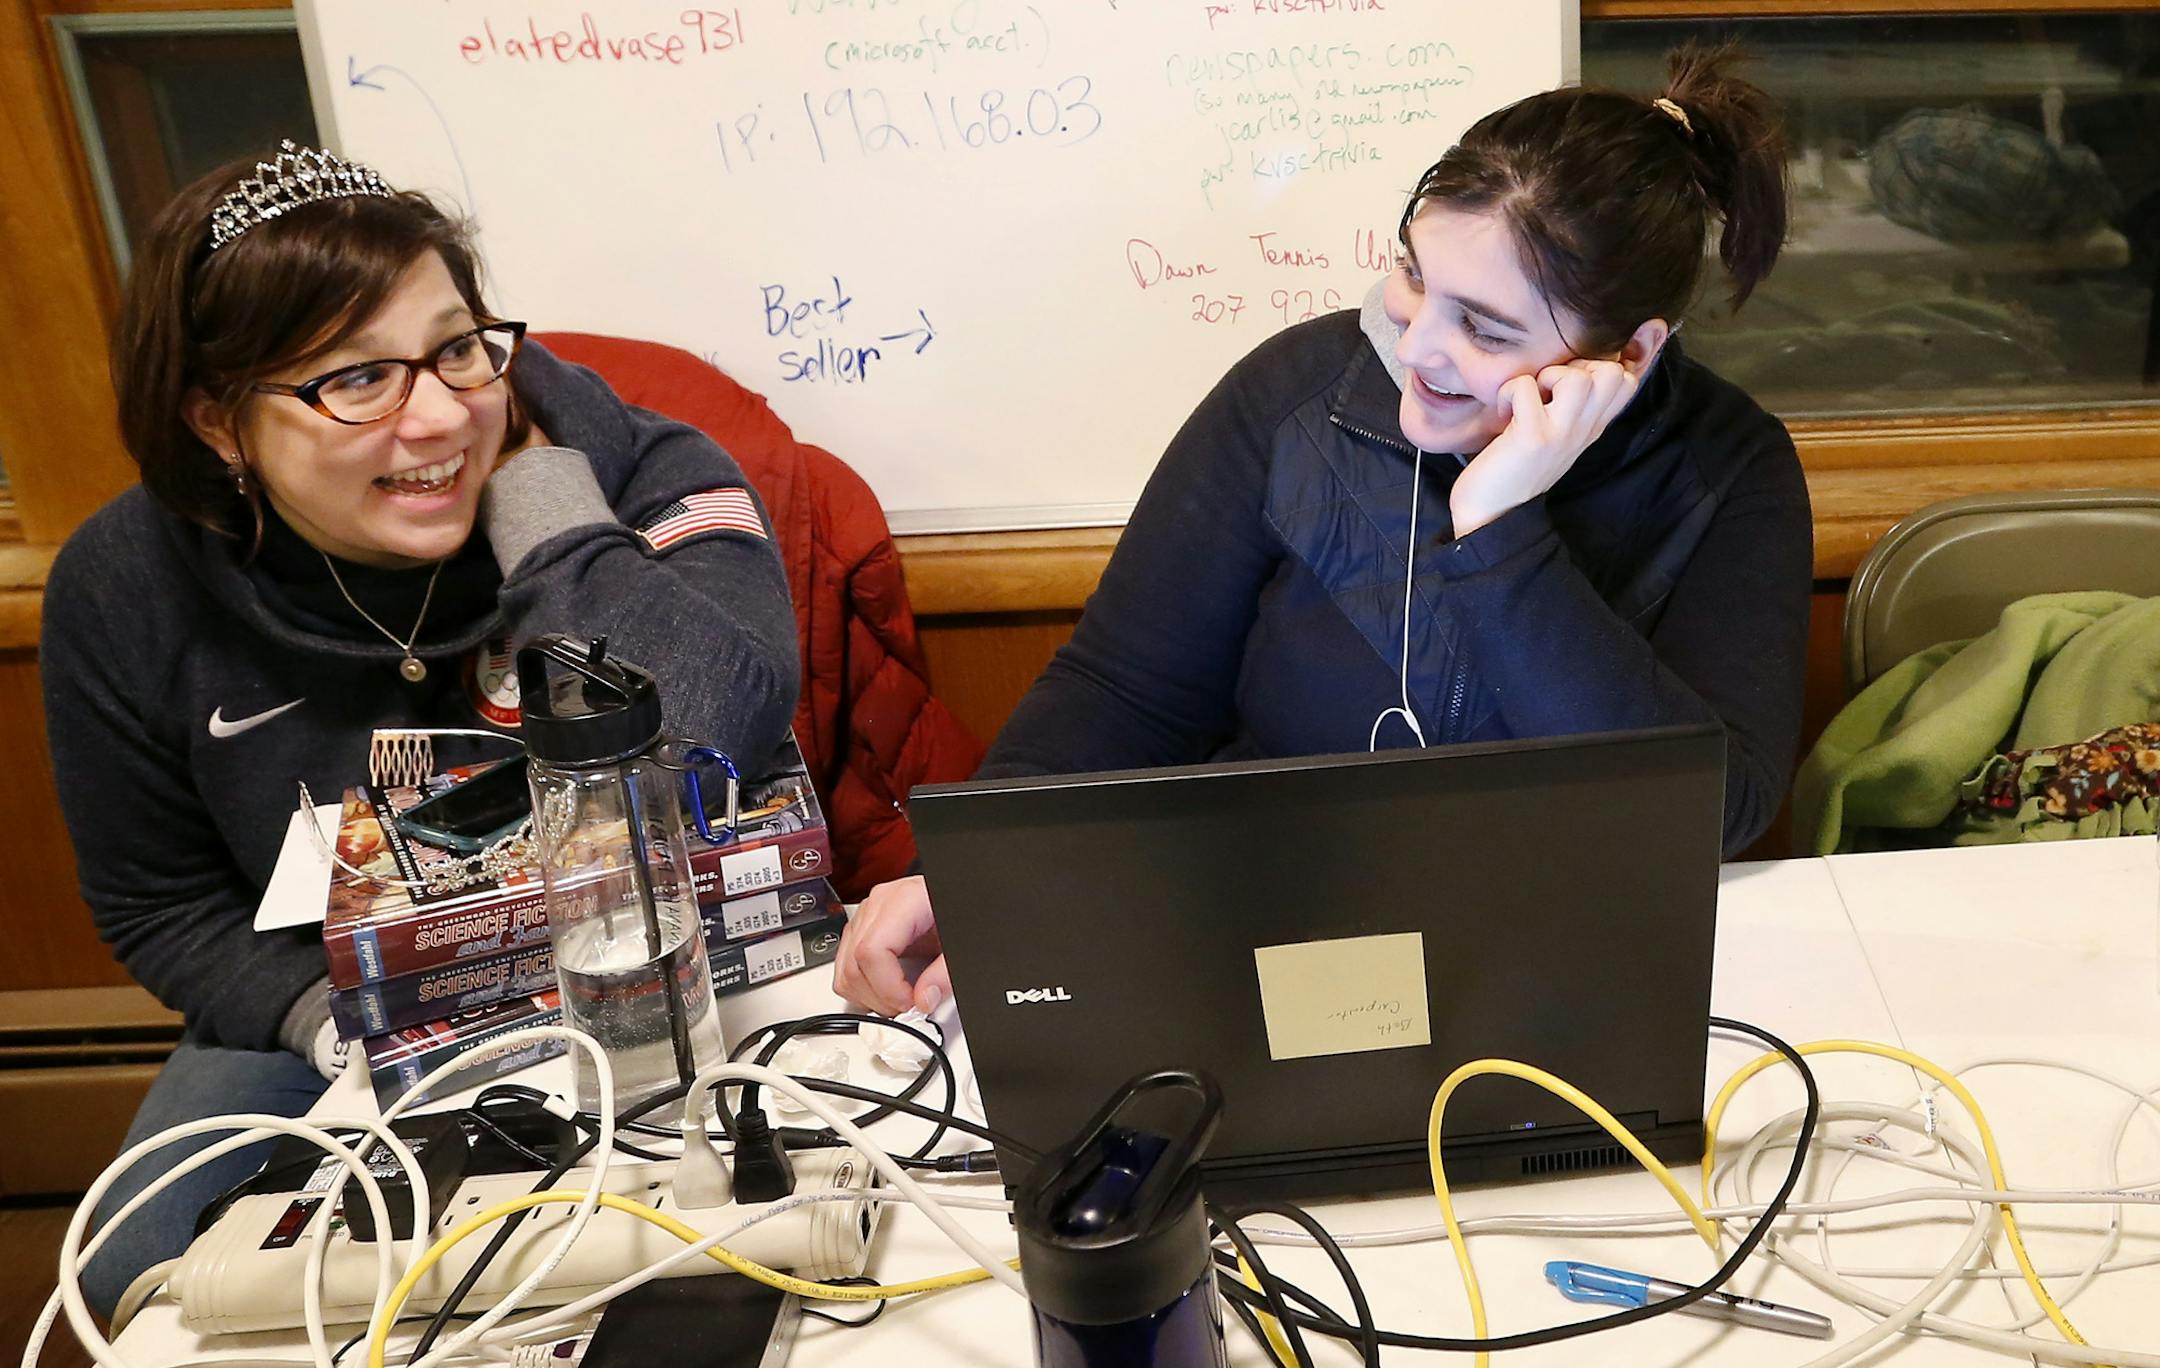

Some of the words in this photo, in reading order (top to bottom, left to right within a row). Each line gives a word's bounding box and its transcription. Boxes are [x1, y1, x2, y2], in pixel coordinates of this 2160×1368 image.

[1236, 89, 1298, 112] many
[1126, 238, 1218, 290] Dawn
[1250, 231, 1330, 269] Tennis
[759, 276, 852, 338] Best
[1191, 292, 1247, 325] 207
[414, 911, 510, 951] SCIENCE
[455, 929, 502, 958] and
[418, 963, 511, 1003] SCIENCE
[458, 980, 504, 1009] and
[1005, 986, 1072, 1005] DELL
